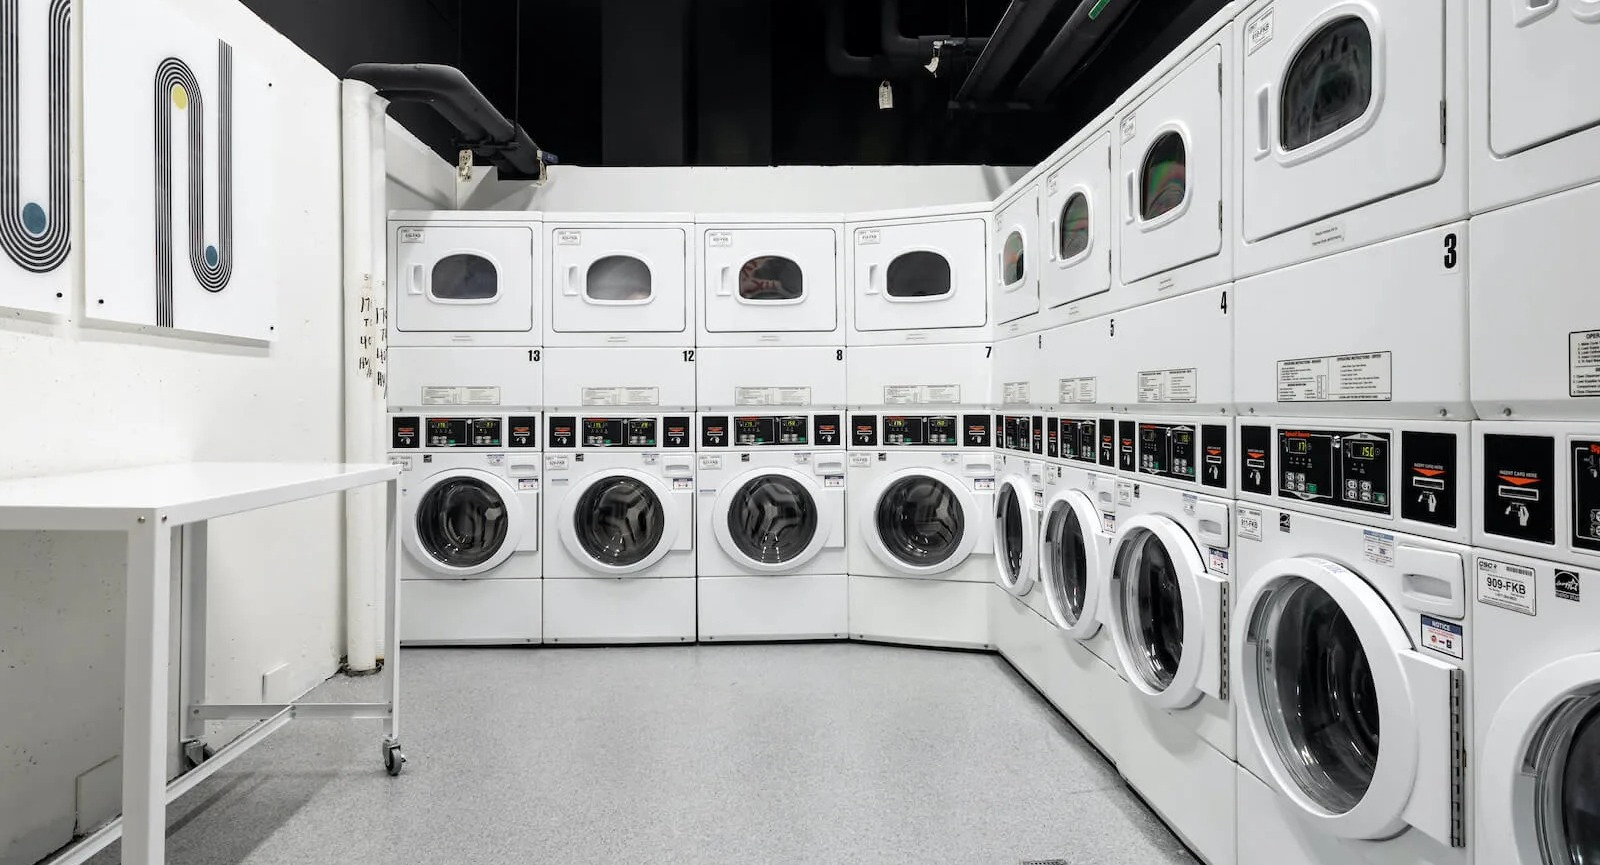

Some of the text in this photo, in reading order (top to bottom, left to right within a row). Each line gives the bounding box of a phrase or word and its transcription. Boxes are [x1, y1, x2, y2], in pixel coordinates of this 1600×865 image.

[1444, 233, 1457, 269] 3
[1220, 291, 1227, 314] 4
[1110, 319, 1115, 336] 5
[528, 350, 541, 361] 13
[683, 350, 695, 361] 12
[836, 350, 843, 360] 8
[985, 347, 992, 358] 7
[1479, 561, 1492, 569] CSC
[1487, 577, 1526, 594] 909-FKB
[1431, 620, 1450, 631] NOTICE
